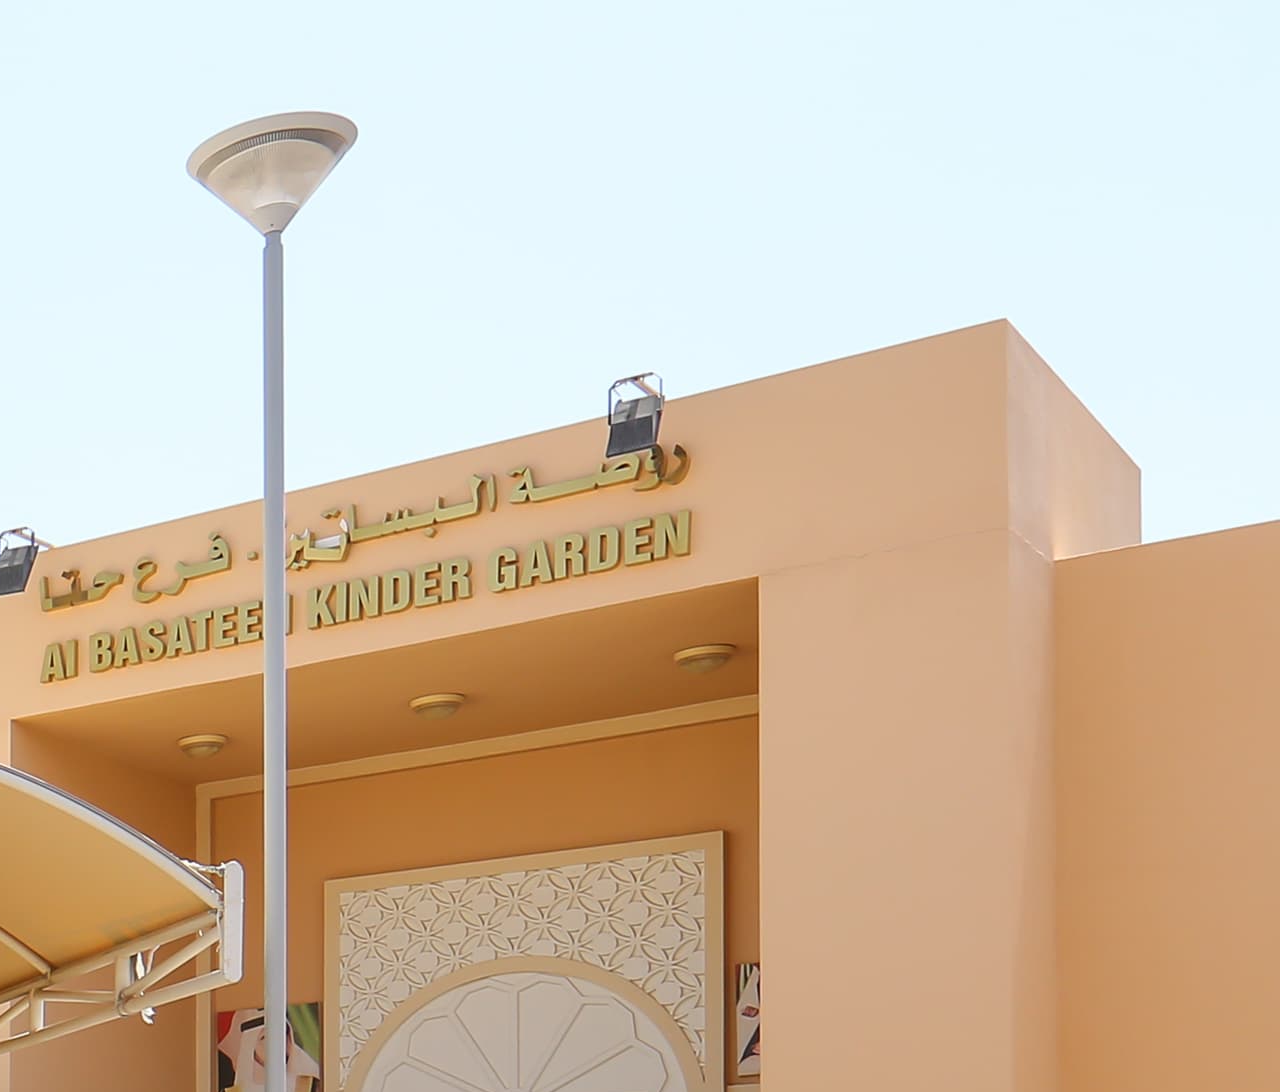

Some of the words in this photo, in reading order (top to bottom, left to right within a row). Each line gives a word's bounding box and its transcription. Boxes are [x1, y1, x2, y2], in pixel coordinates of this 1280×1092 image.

[132, 531, 232, 604] فرع
[306, 556, 473, 630] KINDER
[486, 509, 691, 593] GARDEN
